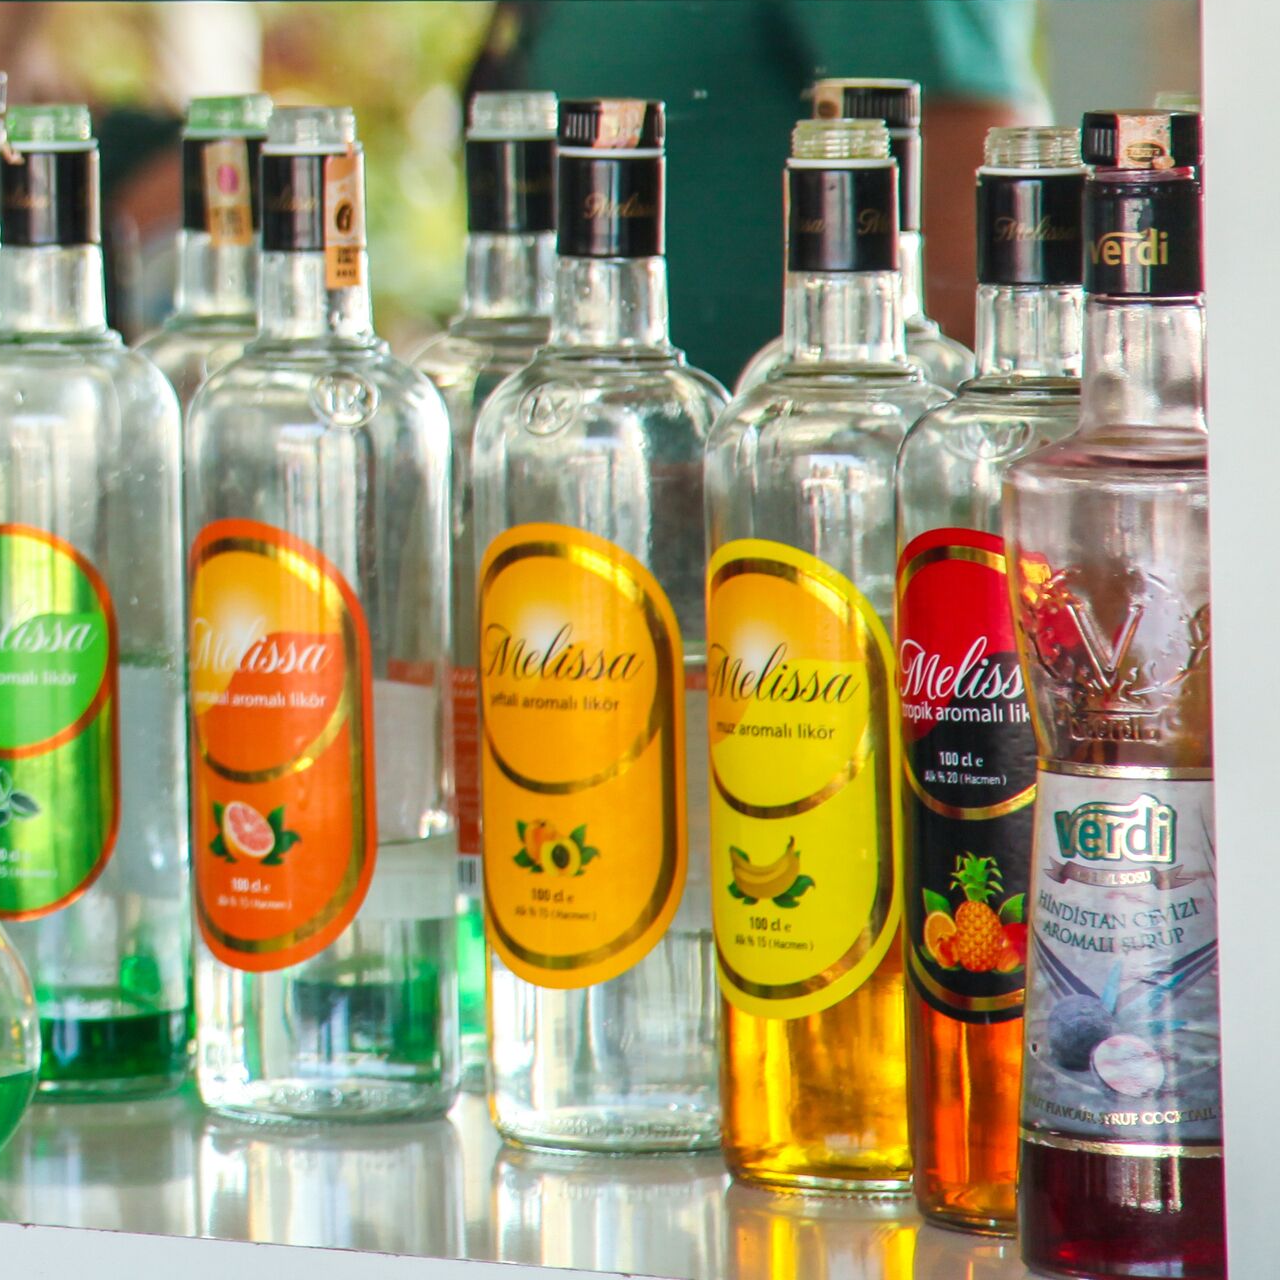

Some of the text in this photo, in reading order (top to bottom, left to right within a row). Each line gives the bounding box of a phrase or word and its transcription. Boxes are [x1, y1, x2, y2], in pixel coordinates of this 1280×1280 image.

[188, 616, 333, 674] Melissa
[485, 623, 644, 683] Melissa
[43, 667, 78, 686] likör
[710, 642, 862, 704] Melissa
[900, 636, 1024, 701] Meliss
[232, 691, 286, 708] aromalı
[289, 690, 327, 709] likör
[522, 695, 578, 711] aromalı
[584, 694, 619, 712] likör
[902, 700, 1030, 724] tropik aromalı lik
[739, 723, 792, 739] aromalı
[798, 723, 836, 740] likör
[939, 751, 959, 766] 100
[961, 752, 972, 767] cl
[947, 772, 958, 784] 20
[1055, 795, 1176, 865] verdi
[1120, 870, 1152, 885] SOSU
[531, 887, 550, 902] 100
[750, 916, 768, 930] 100
[1043, 920, 1114, 953] AROMALI
